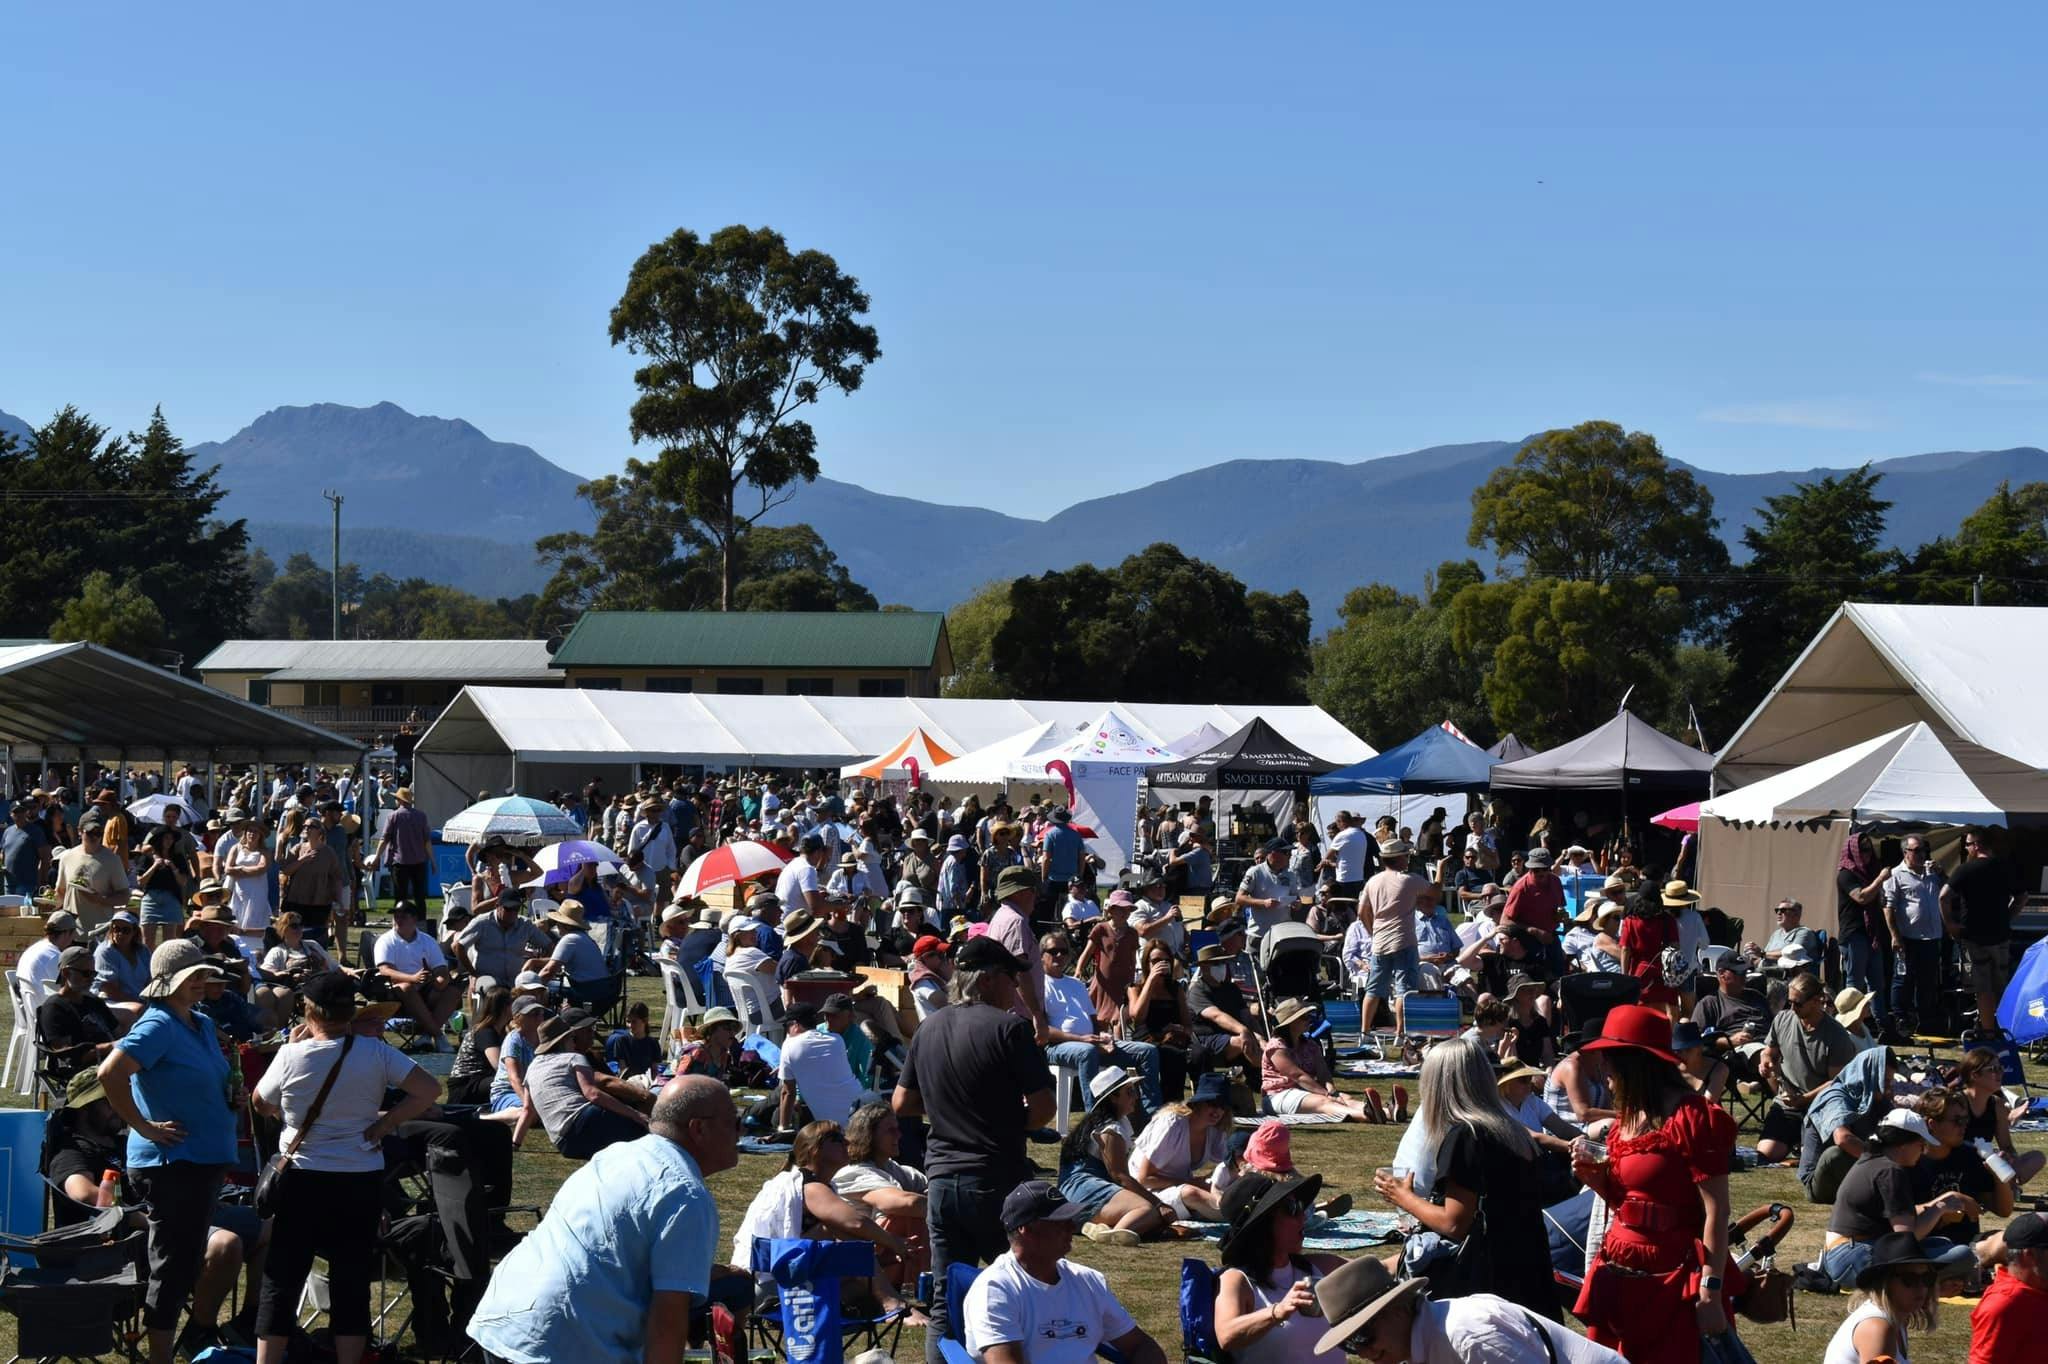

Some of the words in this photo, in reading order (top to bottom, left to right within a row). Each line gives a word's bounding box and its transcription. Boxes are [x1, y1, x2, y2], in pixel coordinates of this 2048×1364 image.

[1109, 766, 1130, 776] FACE
[1155, 772, 1180, 783] ARTISAN
[1180, 772, 1207, 784] SMOKERS
[1224, 773, 1274, 785] SMOKED
[1276, 774, 1301, 785] SALT
